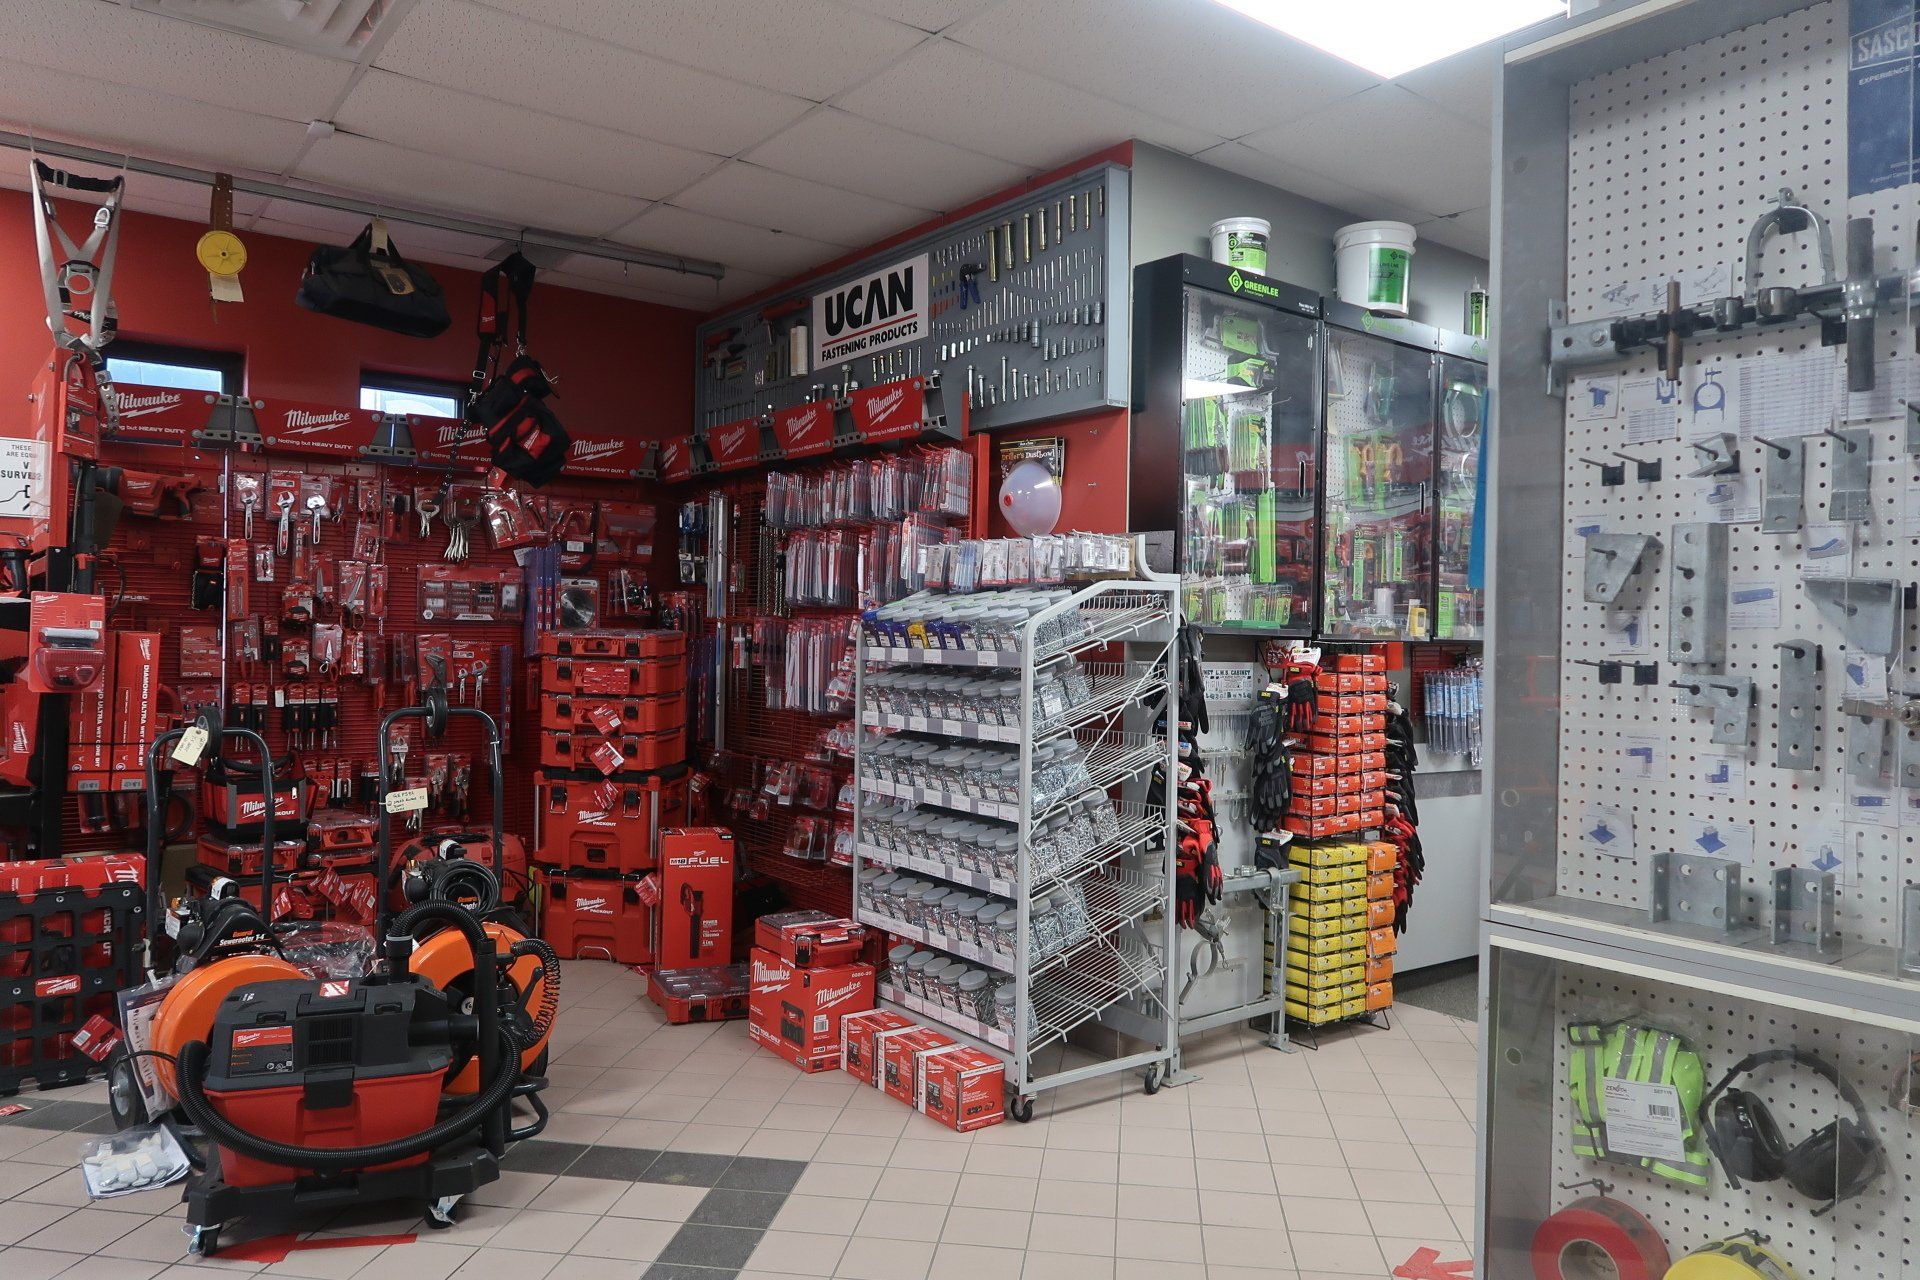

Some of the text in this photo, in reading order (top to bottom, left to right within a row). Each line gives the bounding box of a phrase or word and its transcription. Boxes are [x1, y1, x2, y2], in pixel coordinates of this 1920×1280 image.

[825, 266, 914, 336] UCAN
[1244, 280, 1279, 297] GREENLEE
[822, 321, 918, 362] FASTENING PRODUCTS
[866, 387, 904, 419] Milwaukee
[283, 409, 351, 428] Milwaukee
[786, 408, 816, 436] Milwaukee
[571, 439, 624, 456] Milwaukee
[142, 664, 150, 699] DIAMOND
[140, 701, 148, 724] ULTRA
[688, 856, 730, 864] FUEL
[752, 959, 791, 983] Milwaukee
[815, 980, 862, 1006] Milwaukee
